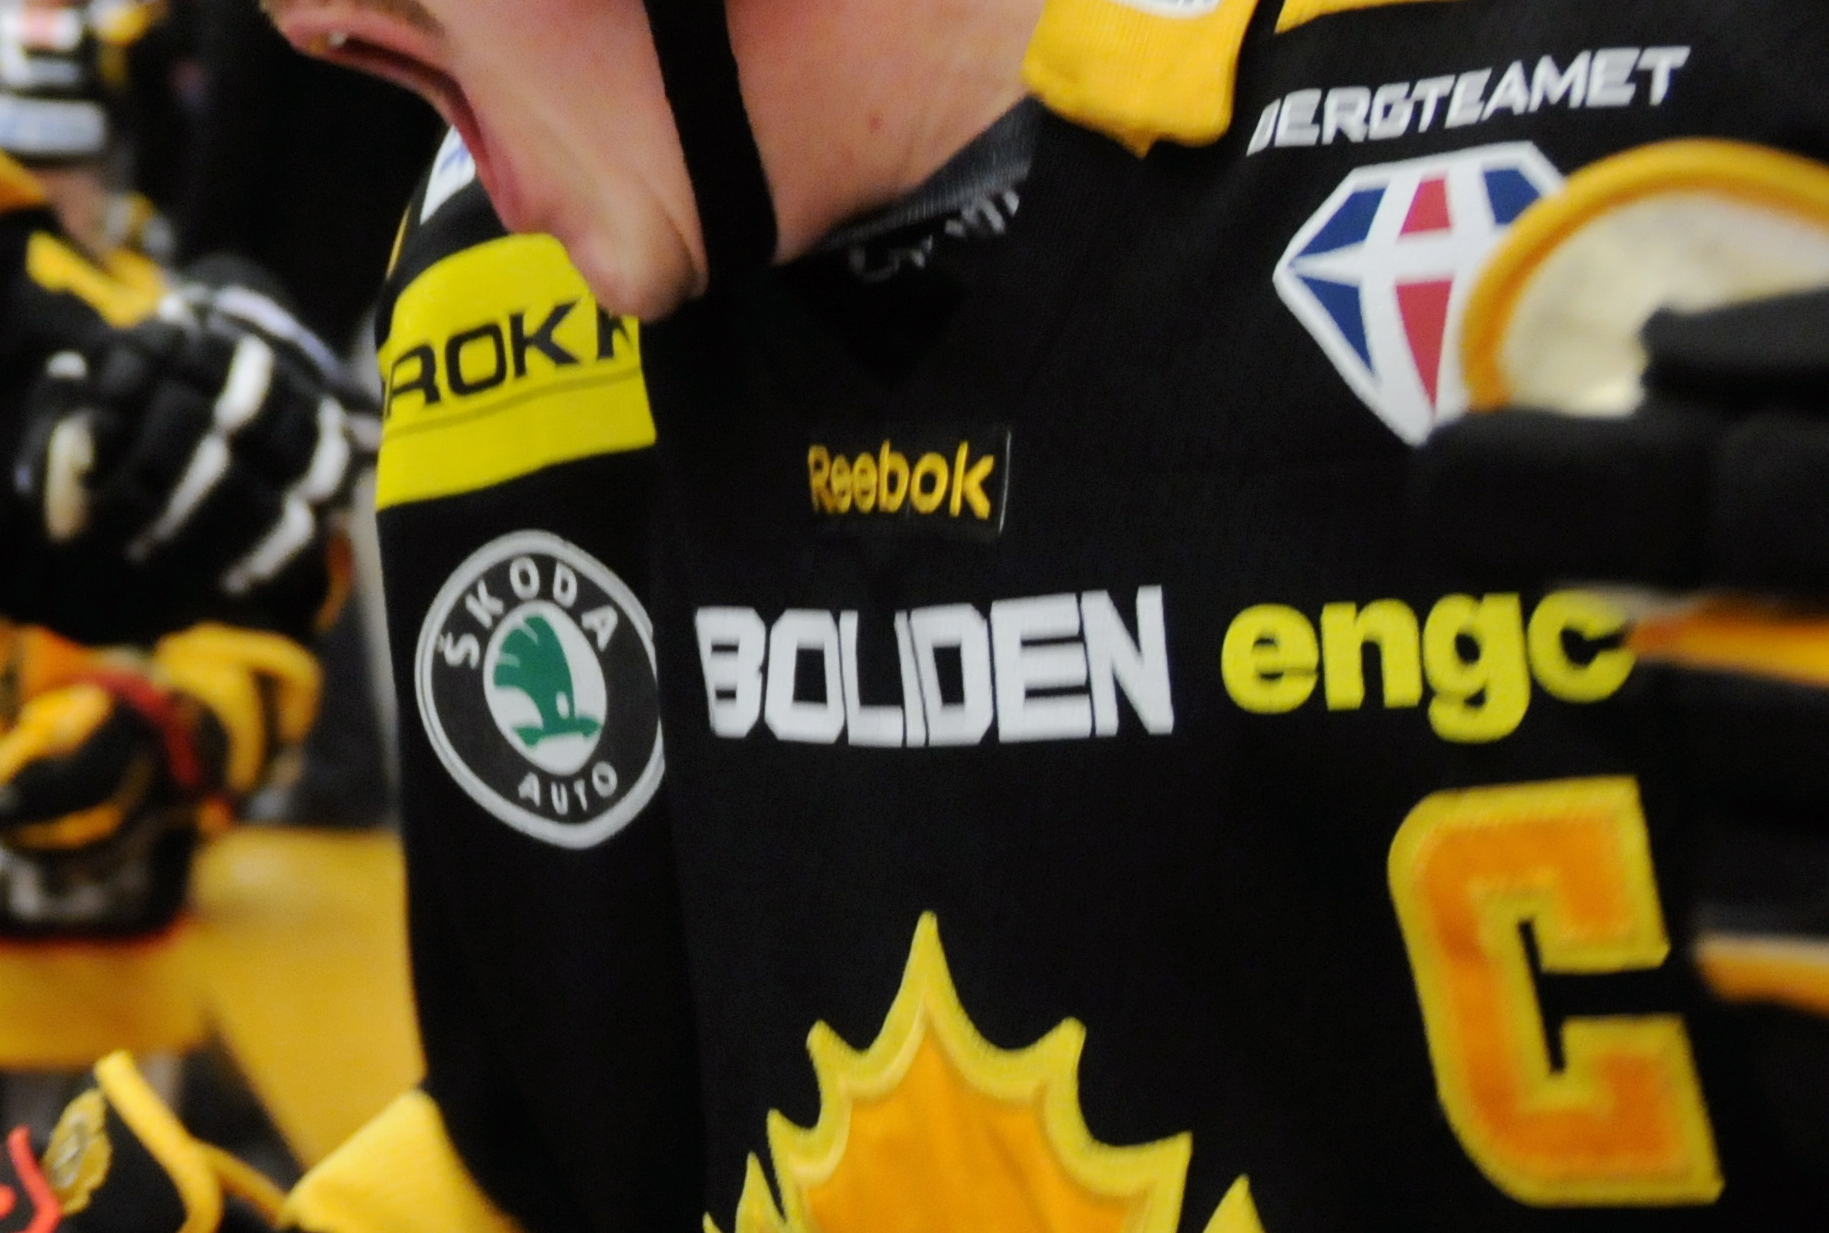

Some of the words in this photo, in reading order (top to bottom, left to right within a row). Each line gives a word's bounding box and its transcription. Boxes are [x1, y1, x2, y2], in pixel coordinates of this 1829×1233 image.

[806, 437, 996, 521] Reebok
[695, 585, 1174, 748] BOLIDEN
[517, 760, 619, 816] AUTO
[1387, 775, 1726, 1208] C
